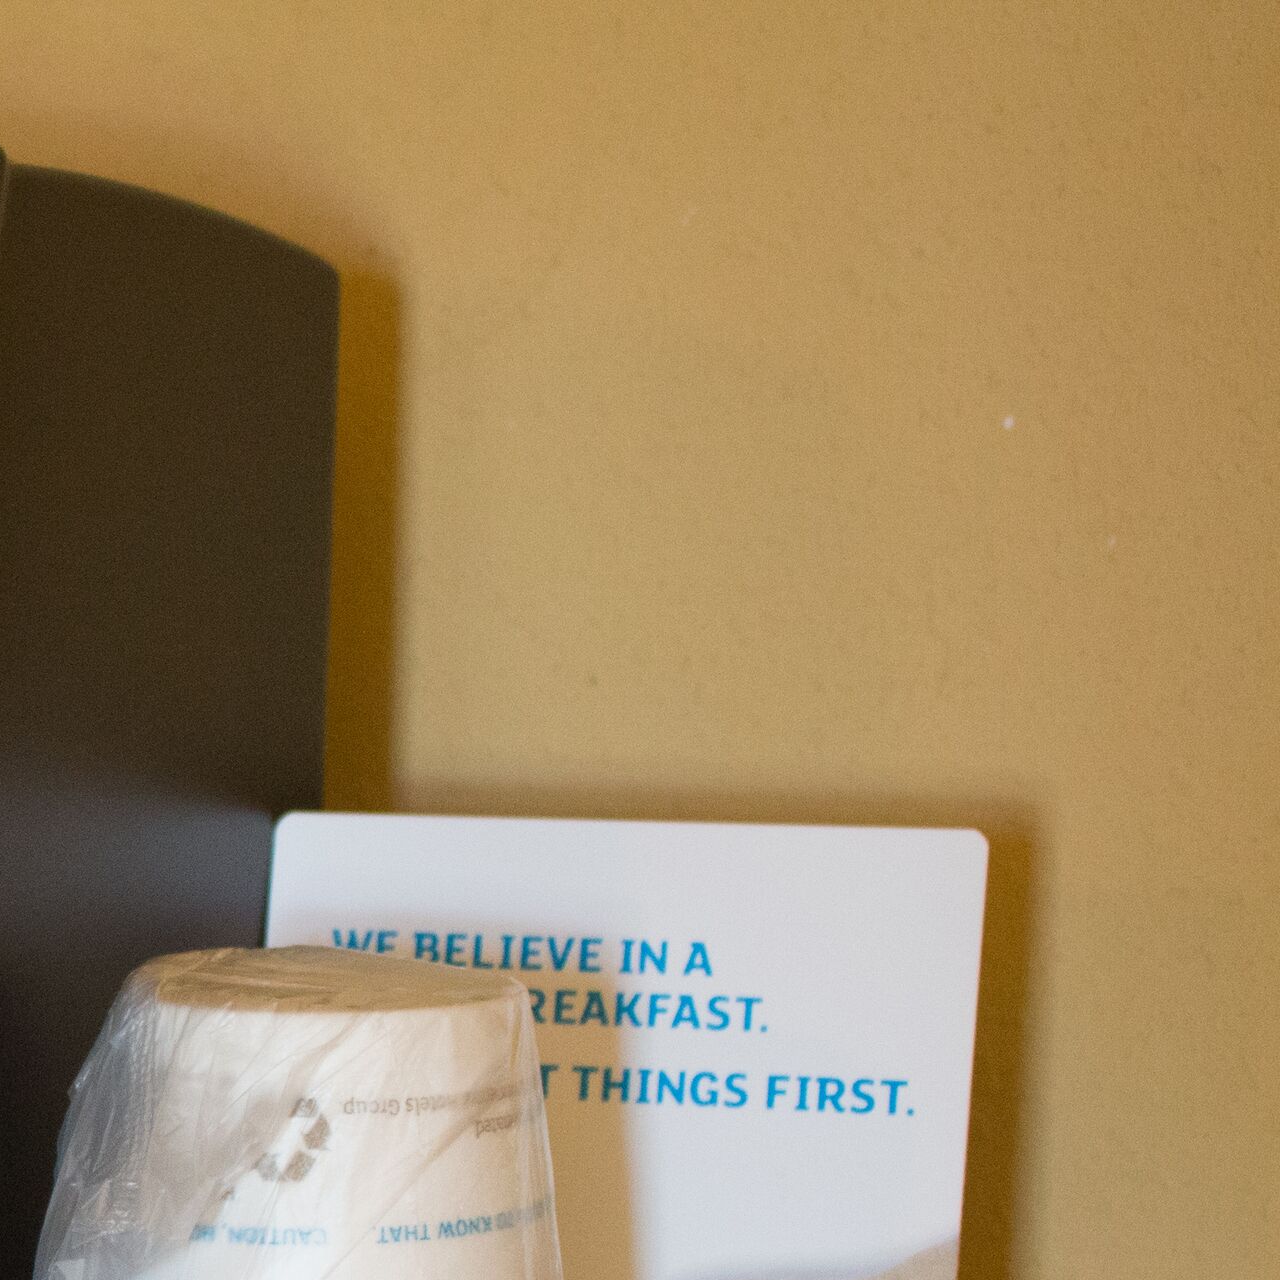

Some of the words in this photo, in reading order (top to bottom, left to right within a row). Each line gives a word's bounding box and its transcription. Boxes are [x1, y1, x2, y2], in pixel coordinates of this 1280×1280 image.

[332, 928, 399, 954] WE
[414, 931, 603, 974] BELIEVE
[618, 938, 668, 975] IN
[683, 941, 713, 977] A
[528, 988, 768, 1033] REAKFAST.
[343, 1096, 401, 1116] Group
[571, 1063, 749, 1108] THINGS
[765, 1073, 915, 1117] FIRST.
[377, 1222, 431, 1244] THAT
[439, 1215, 492, 1239] KNOW
